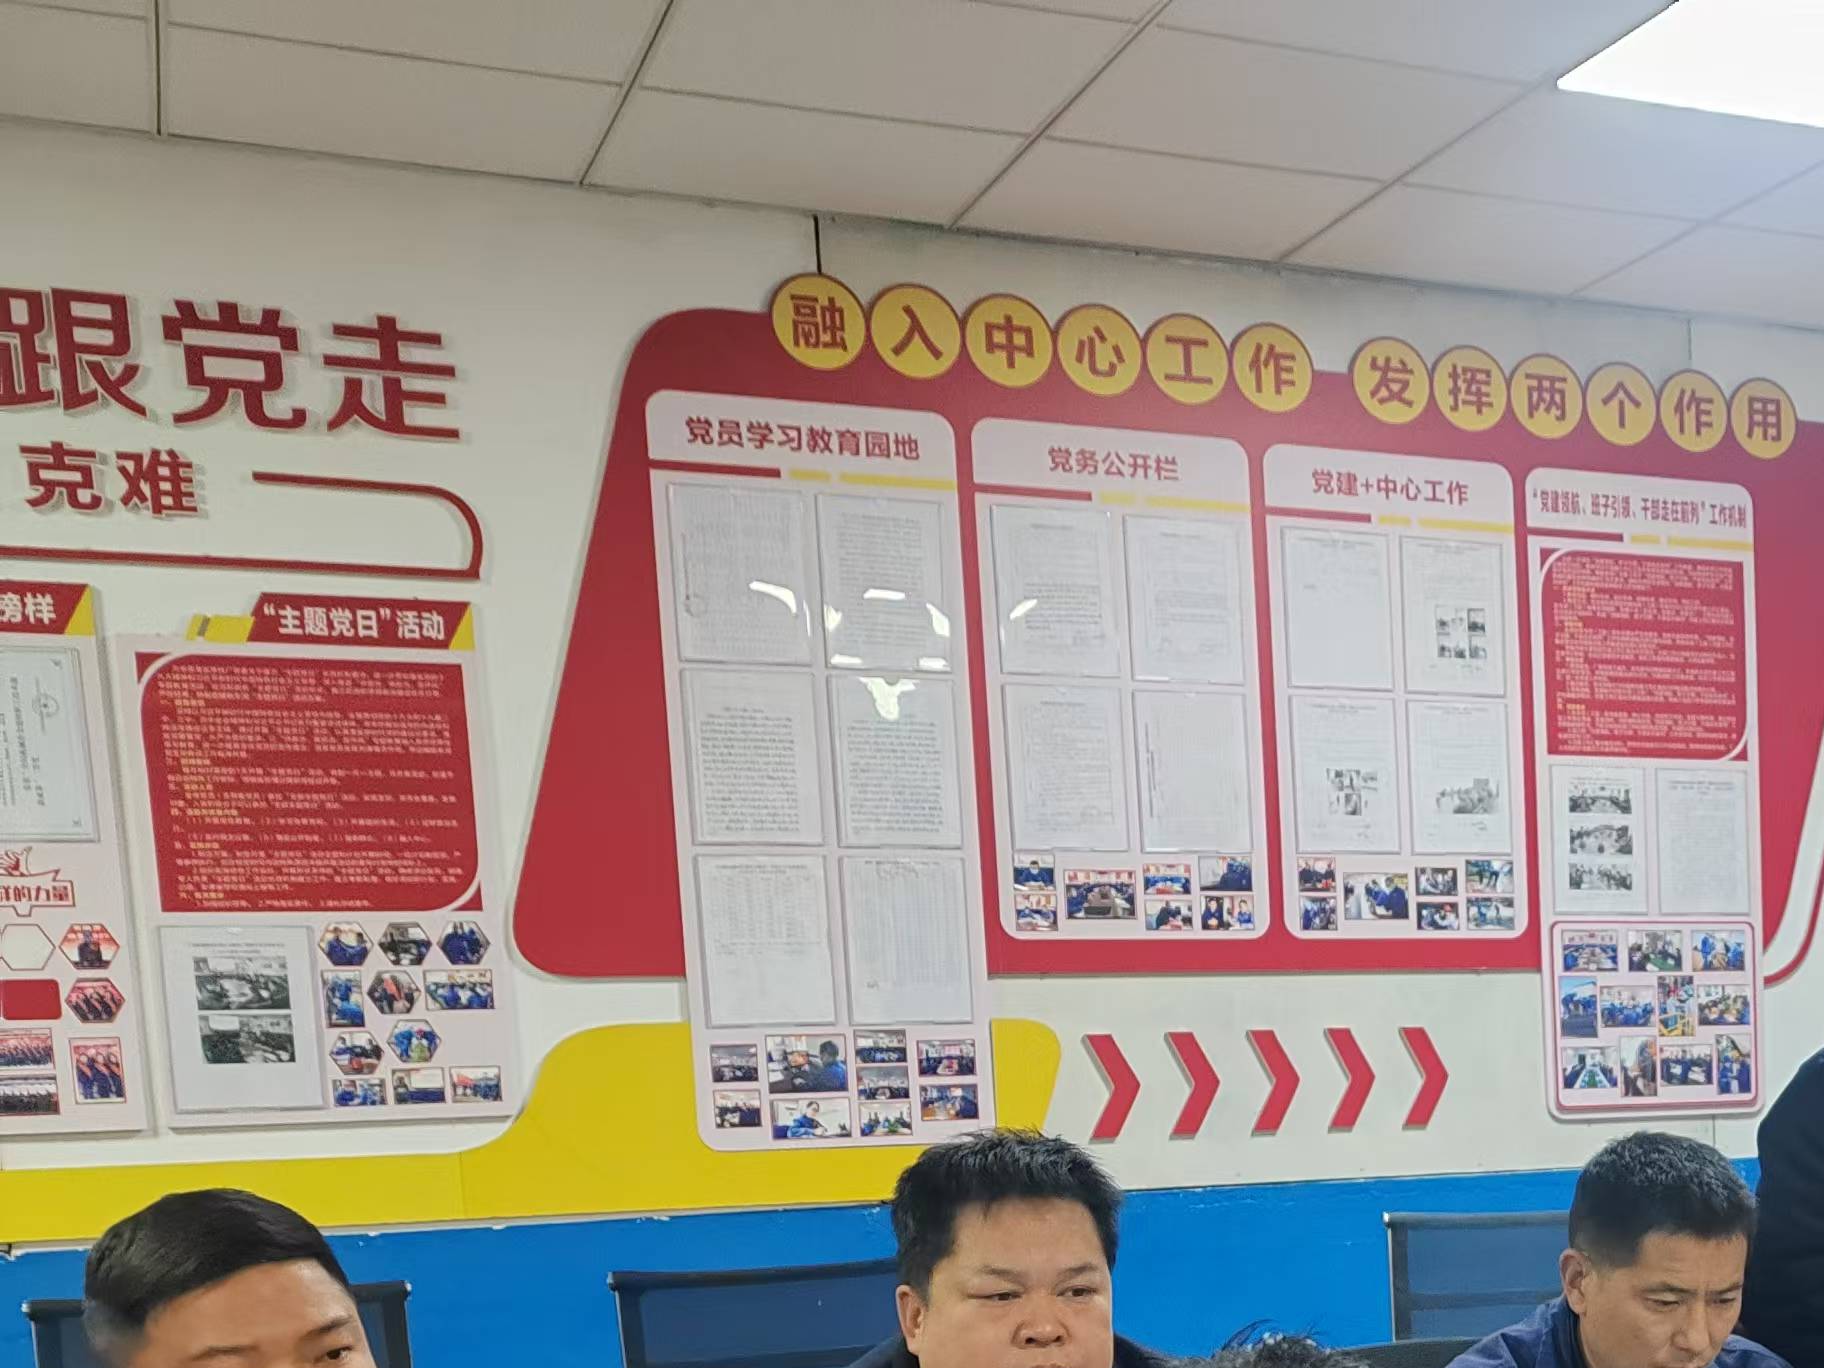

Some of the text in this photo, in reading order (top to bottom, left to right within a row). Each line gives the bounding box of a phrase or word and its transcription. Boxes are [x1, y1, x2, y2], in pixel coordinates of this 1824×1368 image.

[0, 286, 460, 440] 跟党走
[789, 293, 1298, 396] 融入中心工作
[1368, 354, 1783, 444] 发挥两个作用
[685, 416, 920, 460] 党员学习教育园地
[1048, 445, 1180, 481] 党务公开栏
[19, 441, 199, 517] 克难
[1311, 467, 1469, 505] 党建+中心工作
[263, 604, 446, 641] “主题党日”活动
